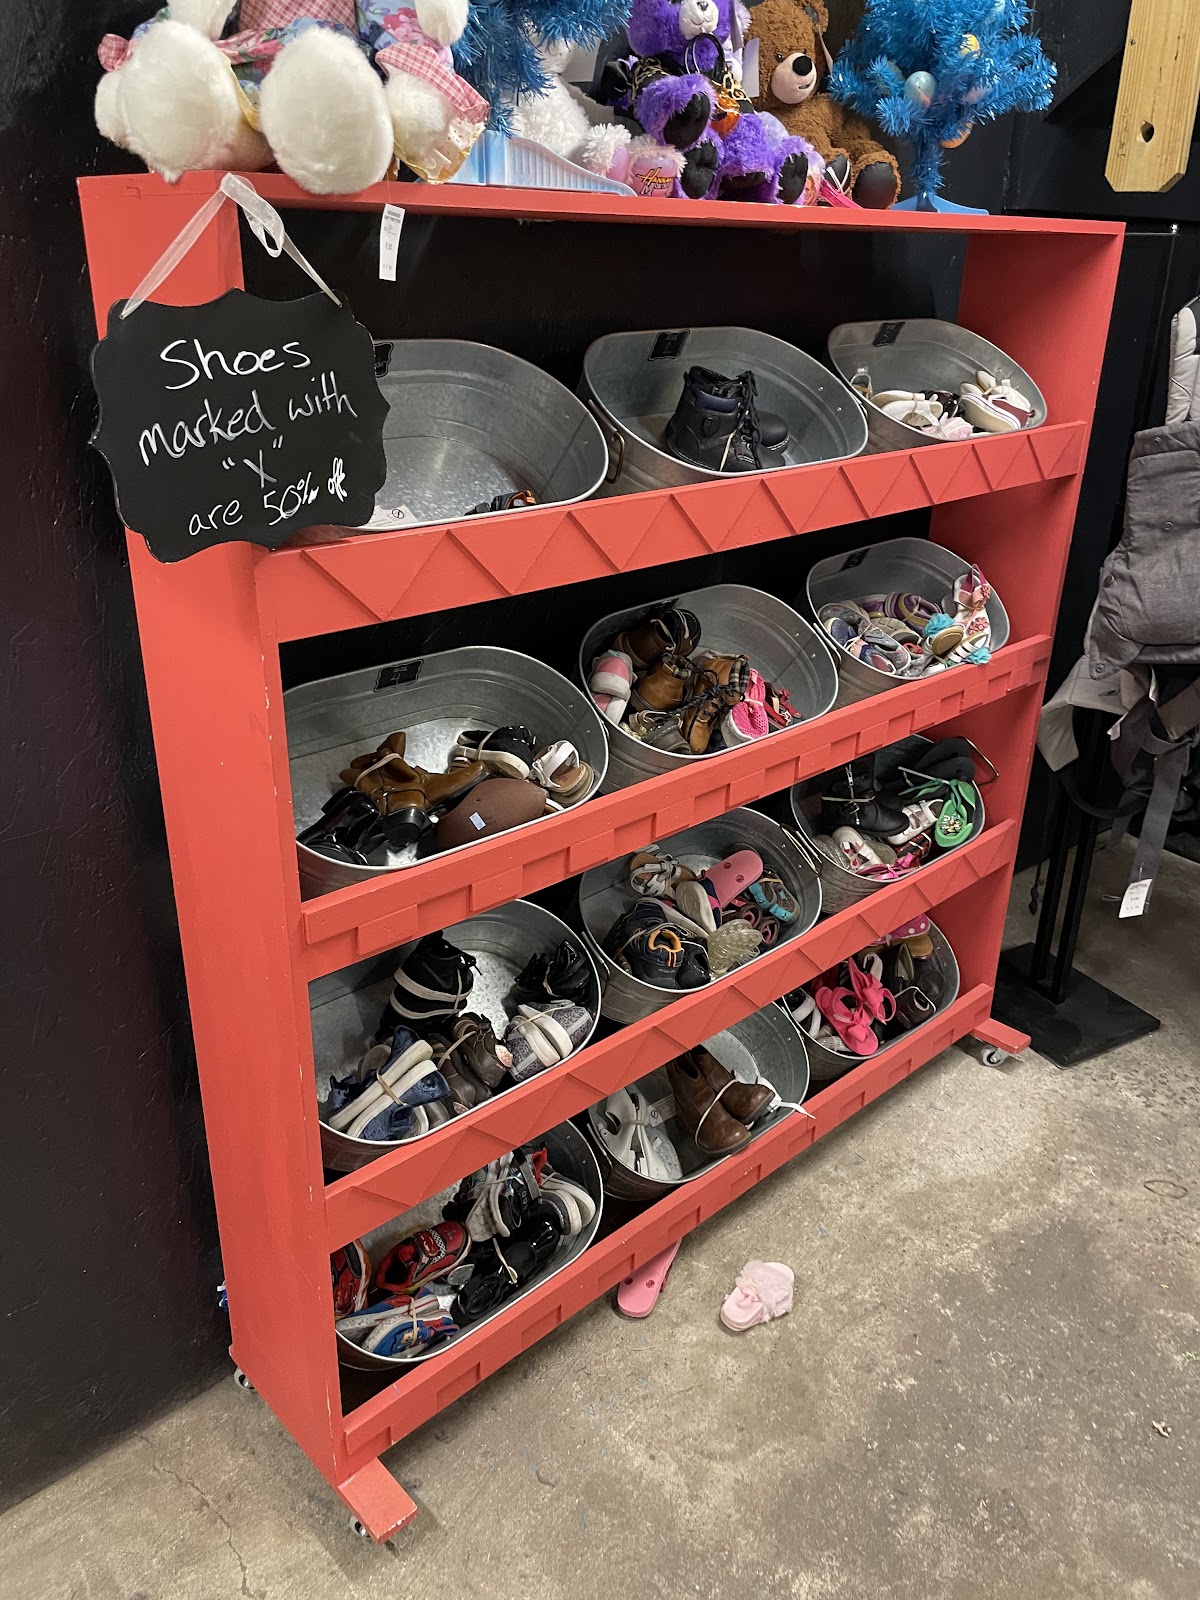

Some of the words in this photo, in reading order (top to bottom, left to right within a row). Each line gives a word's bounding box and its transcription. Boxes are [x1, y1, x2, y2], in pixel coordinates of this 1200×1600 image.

[160, 339, 311, 390] Shoes
[139, 390, 276, 467] marked
[289, 371, 358, 420] with
[189, 500, 244, 536] are
[264, 472, 320, 526] 50%
[327, 456, 348, 503] off
